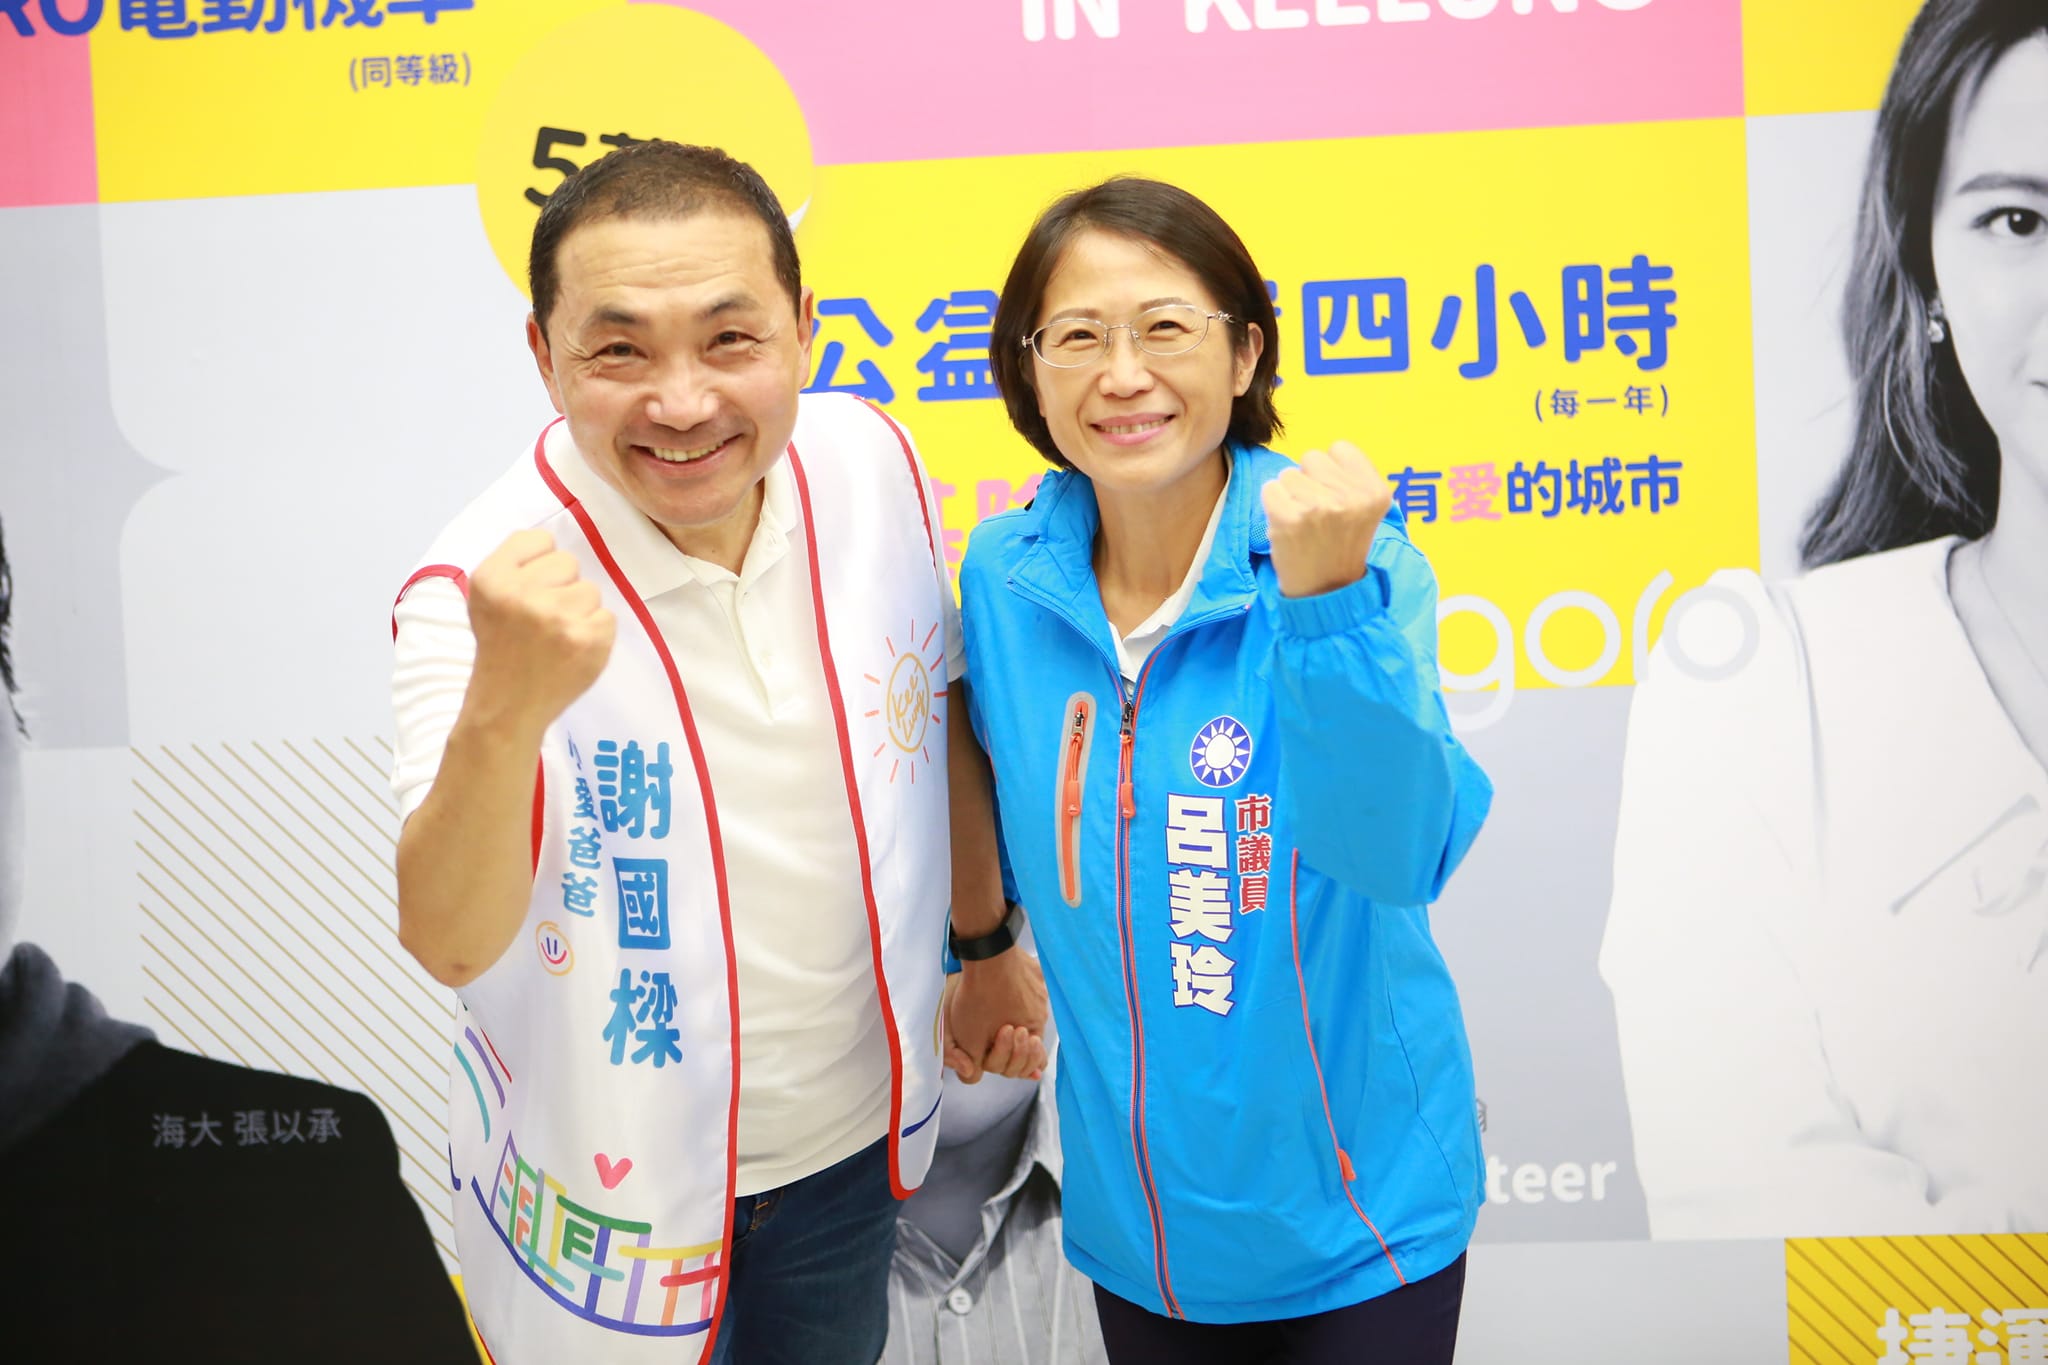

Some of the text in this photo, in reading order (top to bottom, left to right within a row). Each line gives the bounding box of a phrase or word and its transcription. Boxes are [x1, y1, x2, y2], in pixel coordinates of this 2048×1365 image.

[349, 52, 472, 92] (同等級)
[1534, 384, 1669, 422] (每一年)
[593, 739, 683, 1069] 謝國樑
[1165, 792, 1237, 1017] 呂美玲
[1235, 793, 1272, 915] 市議員
